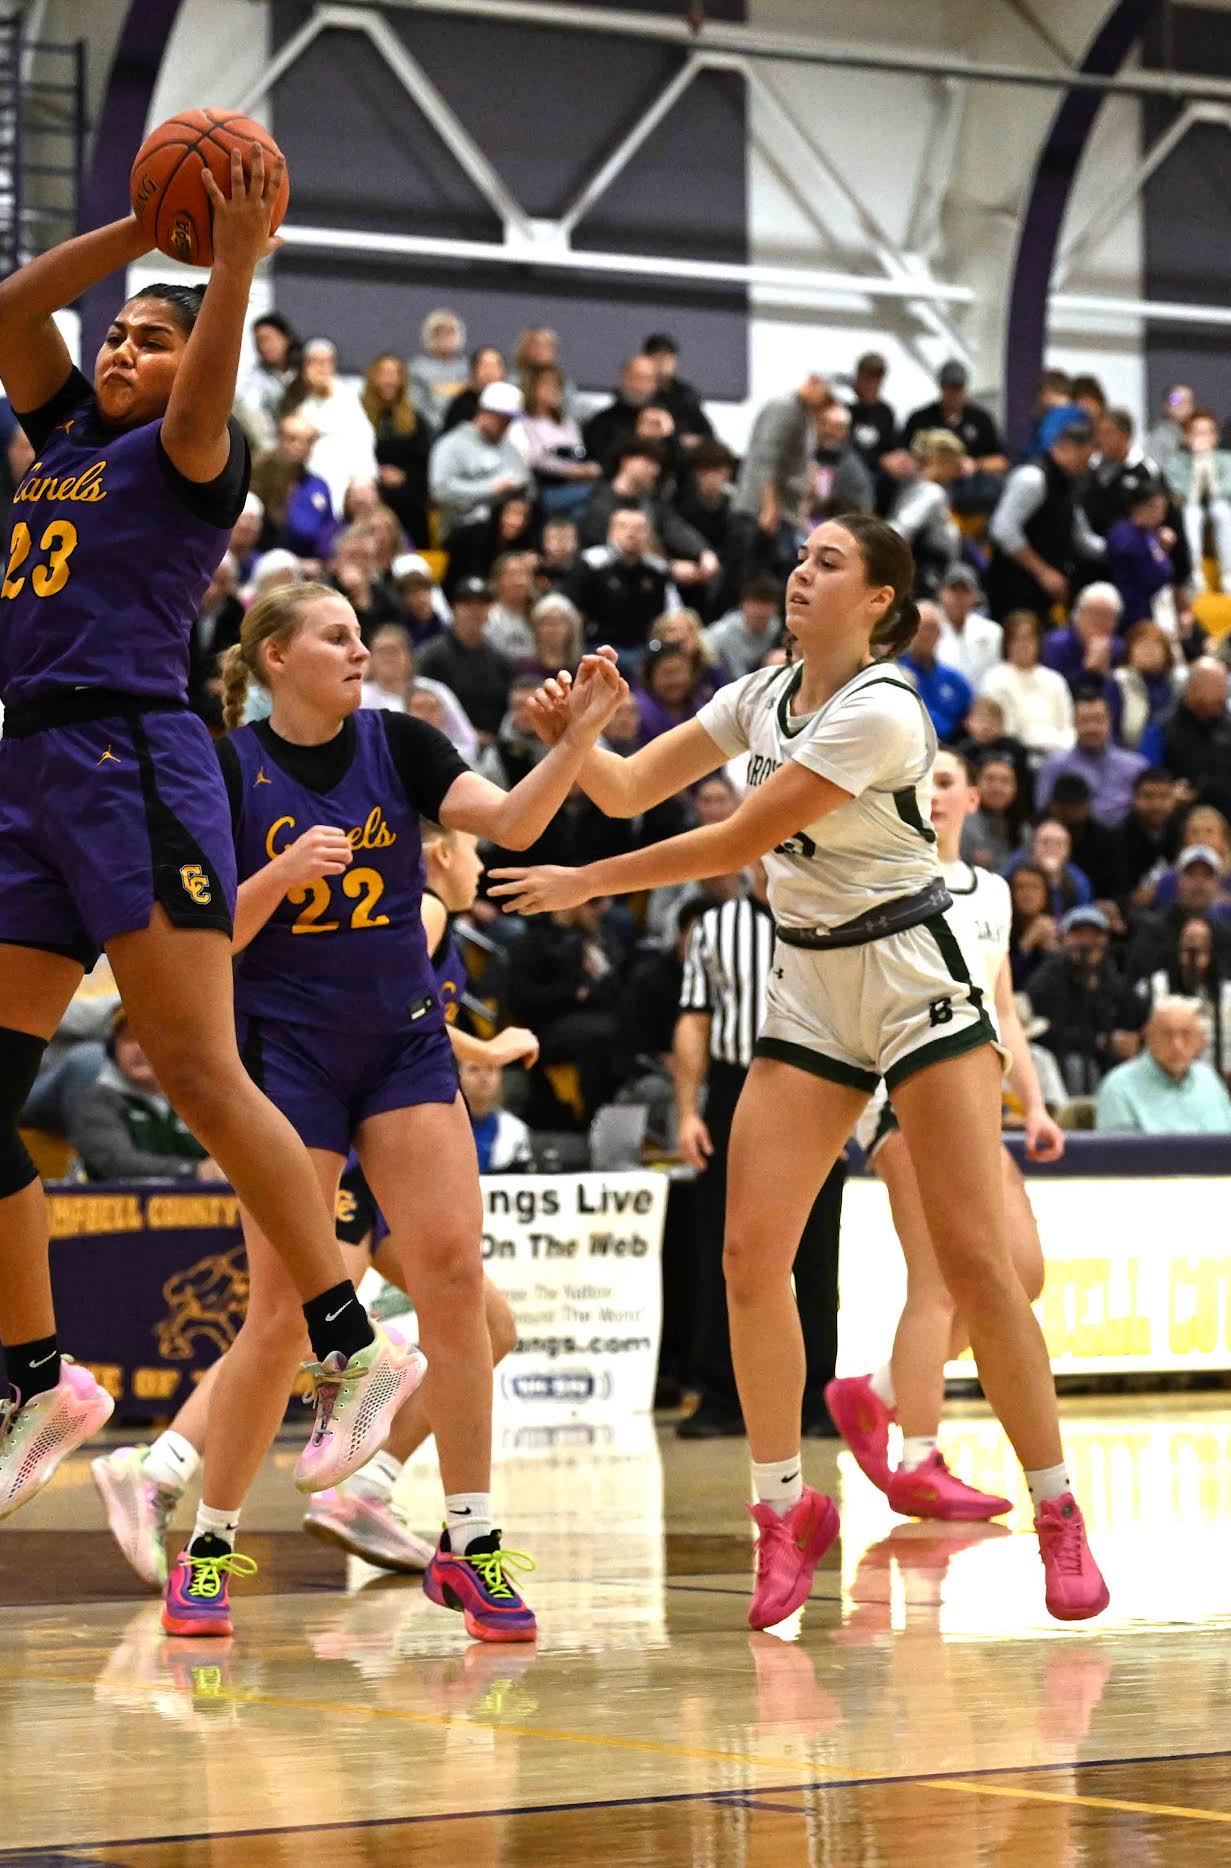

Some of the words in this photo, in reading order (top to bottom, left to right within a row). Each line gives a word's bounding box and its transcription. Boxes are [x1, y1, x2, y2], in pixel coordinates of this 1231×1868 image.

[0, 519, 78, 600] 23
[265, 805, 397, 861] Cels
[287, 866, 391, 935] 22
[929, 996, 954, 1027] B
[488, 1187, 560, 1224] ngs
[577, 1183, 654, 1215] Live
[481, 1233, 516, 1260] On
[529, 1232, 580, 1259] The
[589, 1232, 648, 1259] Web
